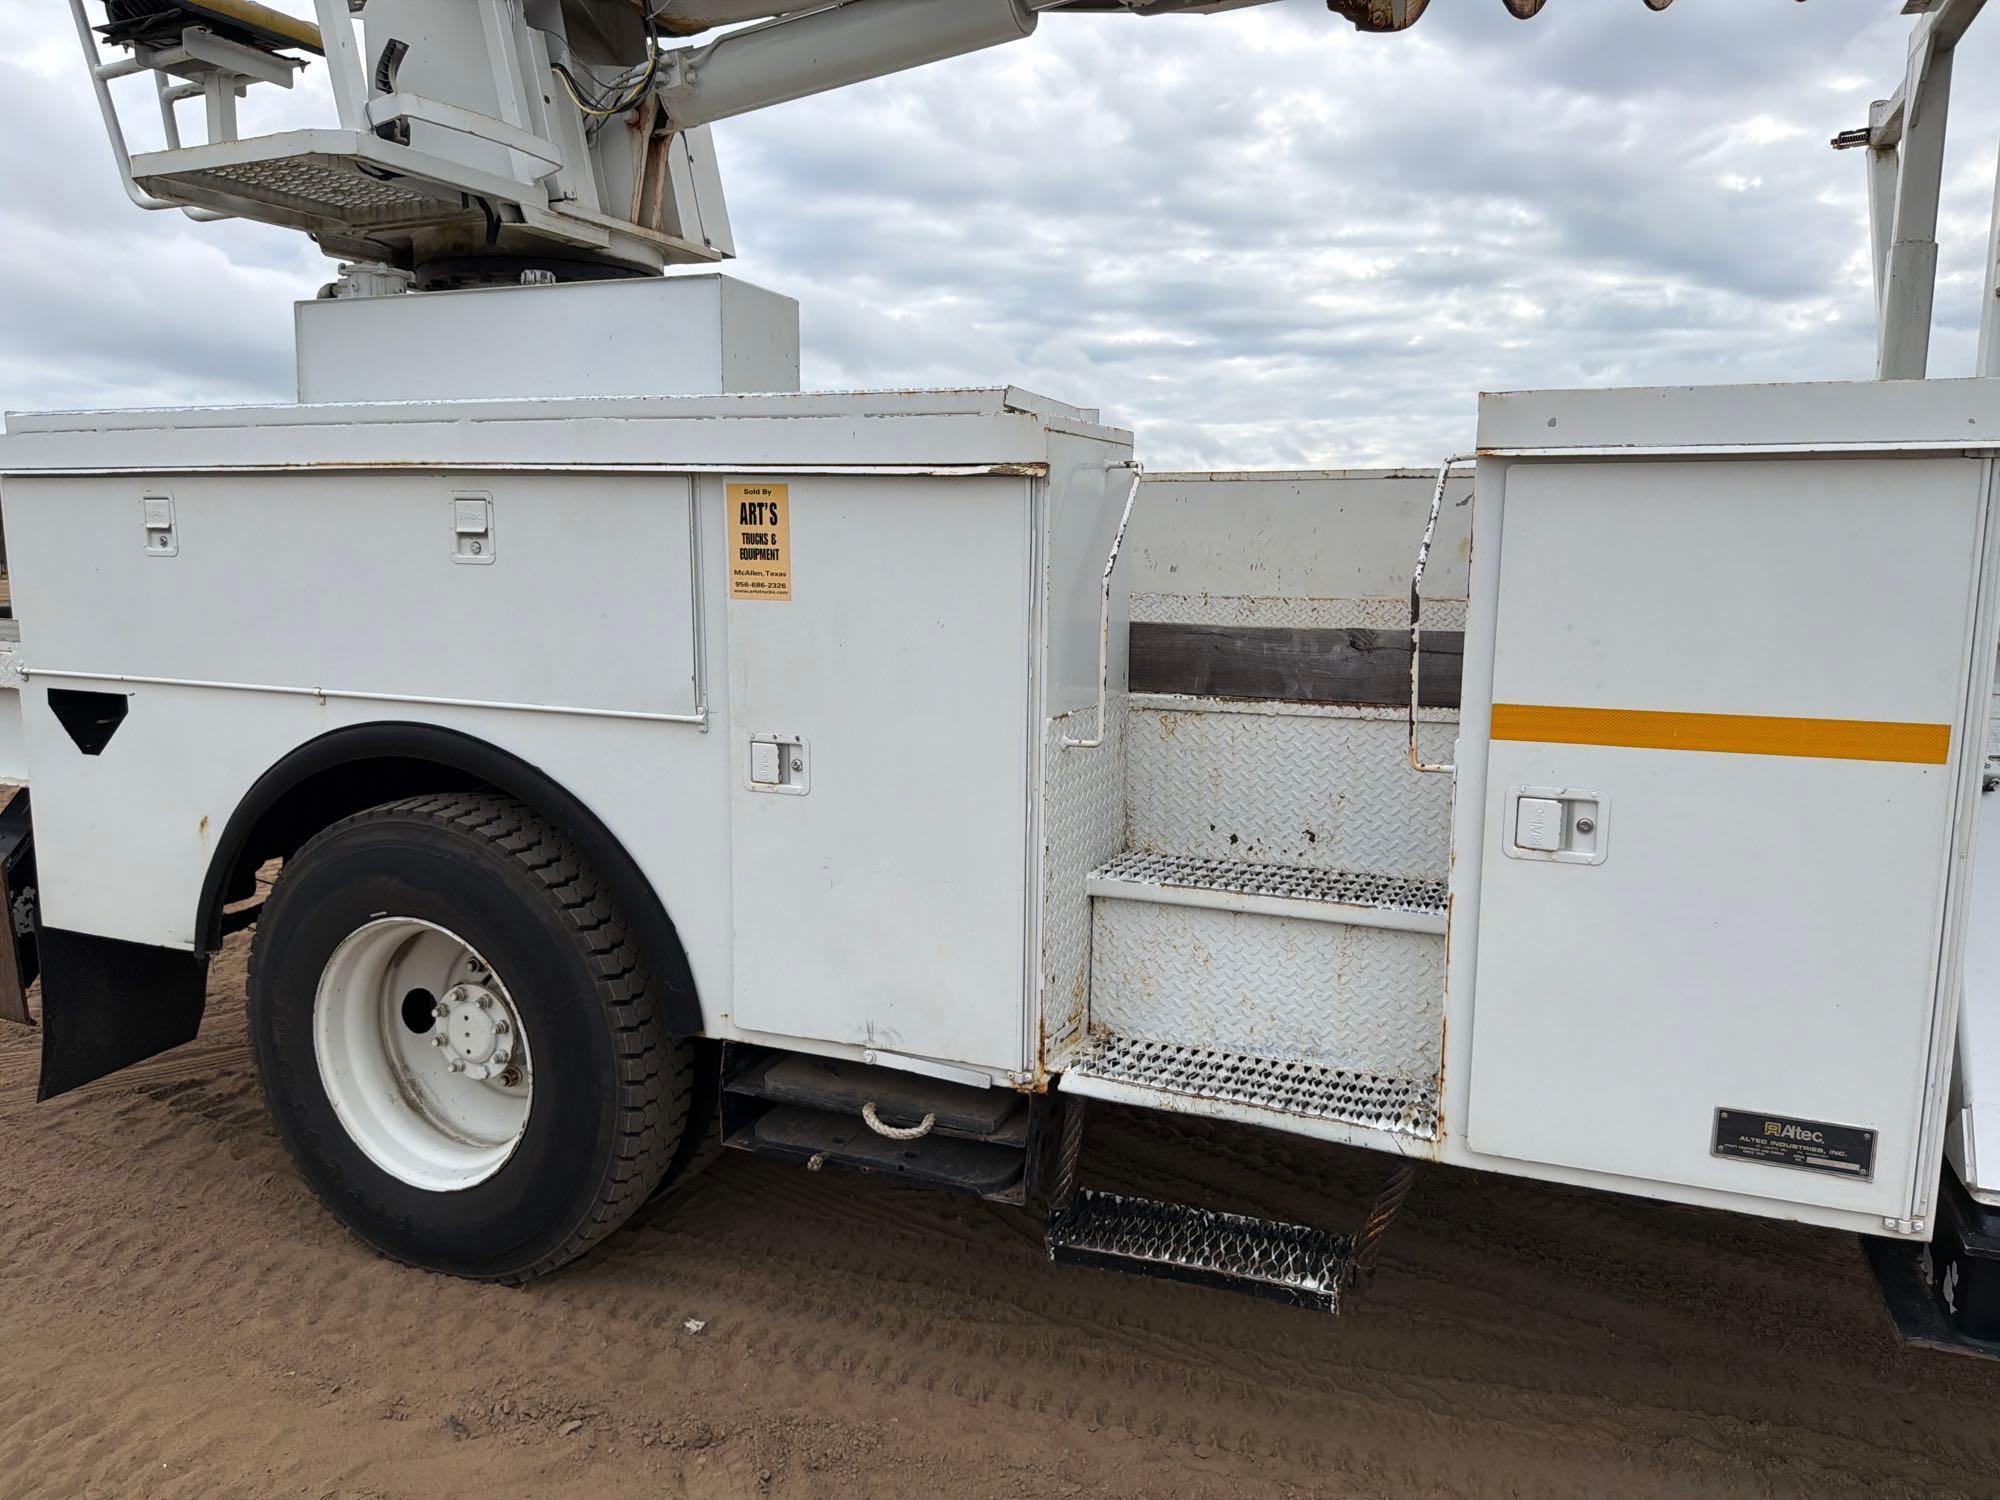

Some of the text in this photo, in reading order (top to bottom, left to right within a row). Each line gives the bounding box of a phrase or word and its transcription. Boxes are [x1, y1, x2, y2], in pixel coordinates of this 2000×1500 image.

[762, 488, 772, 496] By
[739, 502, 778, 526] ART'S
[741, 532, 777, 545] TRUCKS &
[739, 548, 780, 561] EQUIPMENT
[734, 569, 787, 578] McAllen, Texas
[735, 581, 786, 589] 956-686-2326
[1781, 1124, 1823, 1142] Altec
[1739, 1136, 1768, 1145] ALTEC
[1769, 1141, 1826, 1155] INDUSTRIES,
[1829, 1149, 1848, 1157] INC.
